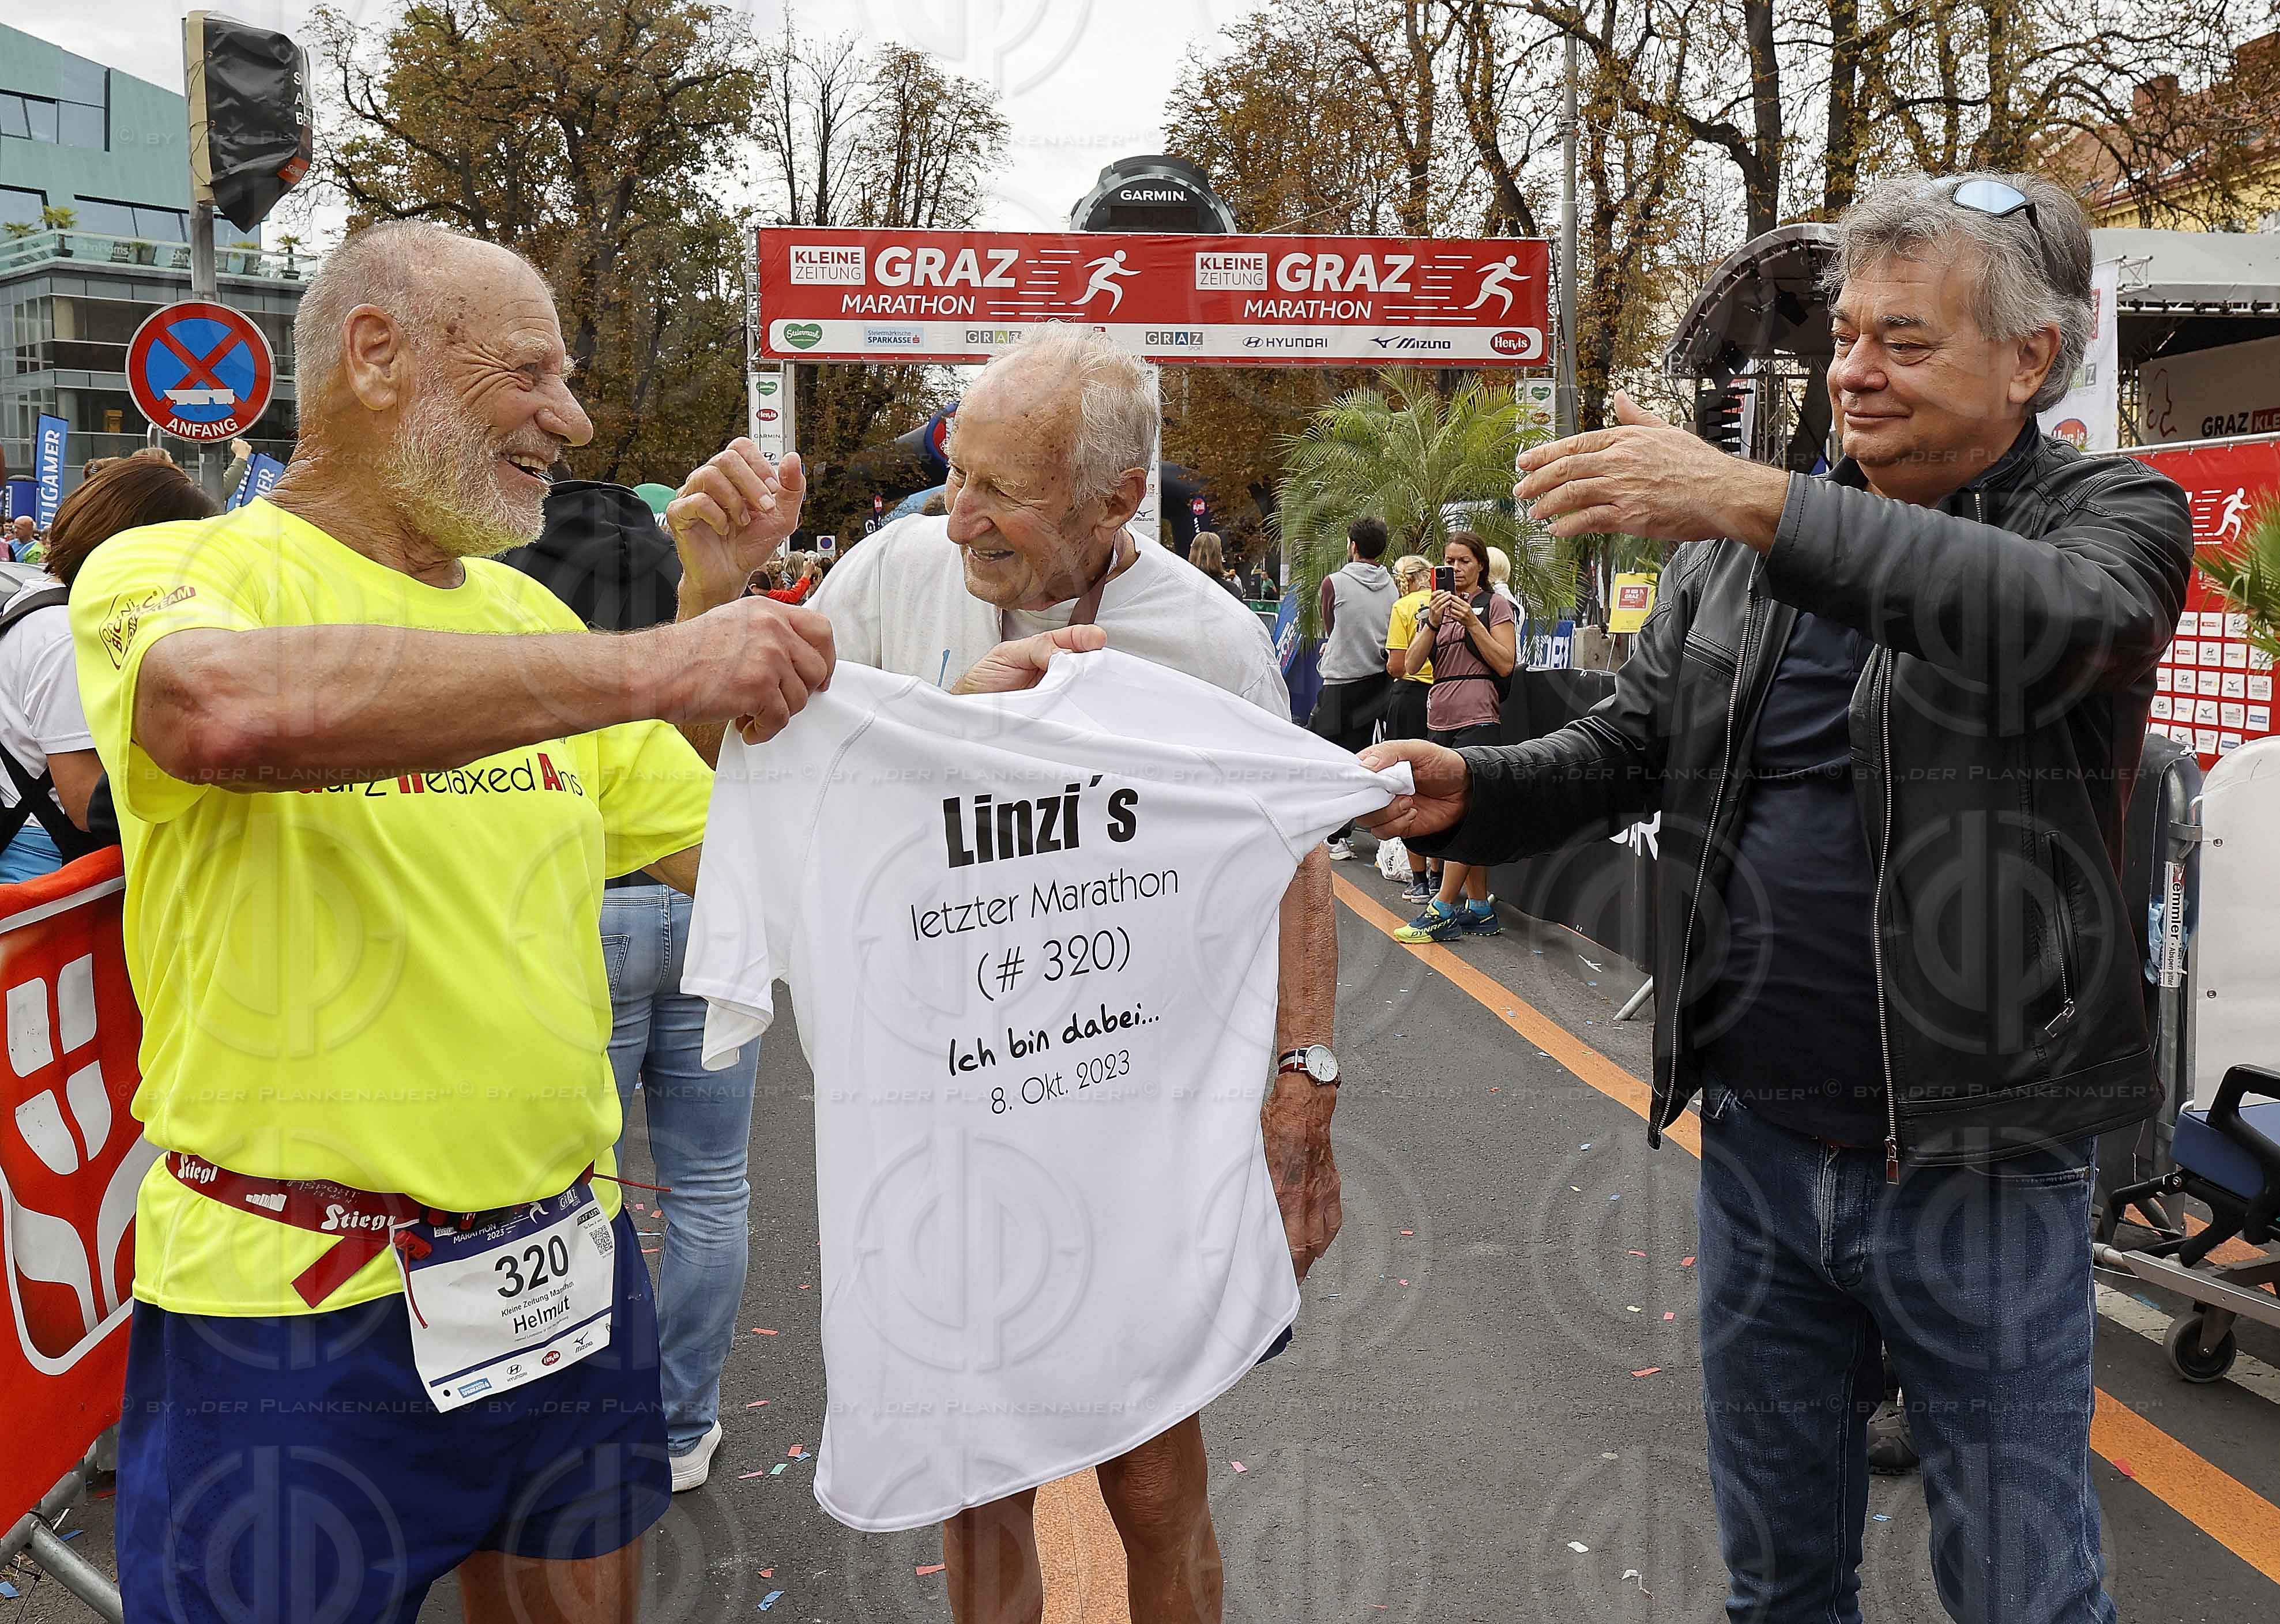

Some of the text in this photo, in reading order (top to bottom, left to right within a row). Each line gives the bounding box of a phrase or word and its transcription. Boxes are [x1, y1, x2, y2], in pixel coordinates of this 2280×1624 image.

[795, 251, 861, 265] KLEINE
[874, 246, 1019, 288] GRAZ
[1200, 257, 1263, 270] KLEINE
[795, 266, 861, 280] ZEITUNG
[1200, 272, 1263, 286] ZEITUNG
[1276, 252, 1415, 292] GRAZ
[841, 294, 976, 315] MARATHON
[1243, 299, 1372, 319] MARATHON
[867, 336, 911, 344] SPARKASSE
[1146, 332, 1202, 345] GRAZ
[1266, 337, 1328, 348] HYUNDAI
[1494, 336, 1527, 351] Hervis
[166, 417, 239, 439] ANFANG
[910, 868, 1179, 941] letzter Marathon
[1410, 918, 1452, 938] DYNAFIT
[949, 1038, 996, 1076] Ich
[1007, 1027, 1049, 1058] bin
[991, 1049, 1130, 1114] 8. Okt. 2023
[486, 1229, 505, 1241] 2023
[494, 1234, 569, 1298] 320
[501, 1304, 522, 1318] Kleine
[522, 1293, 550, 1309] Zeitung
[513, 1295, 570, 1334] Helmut
